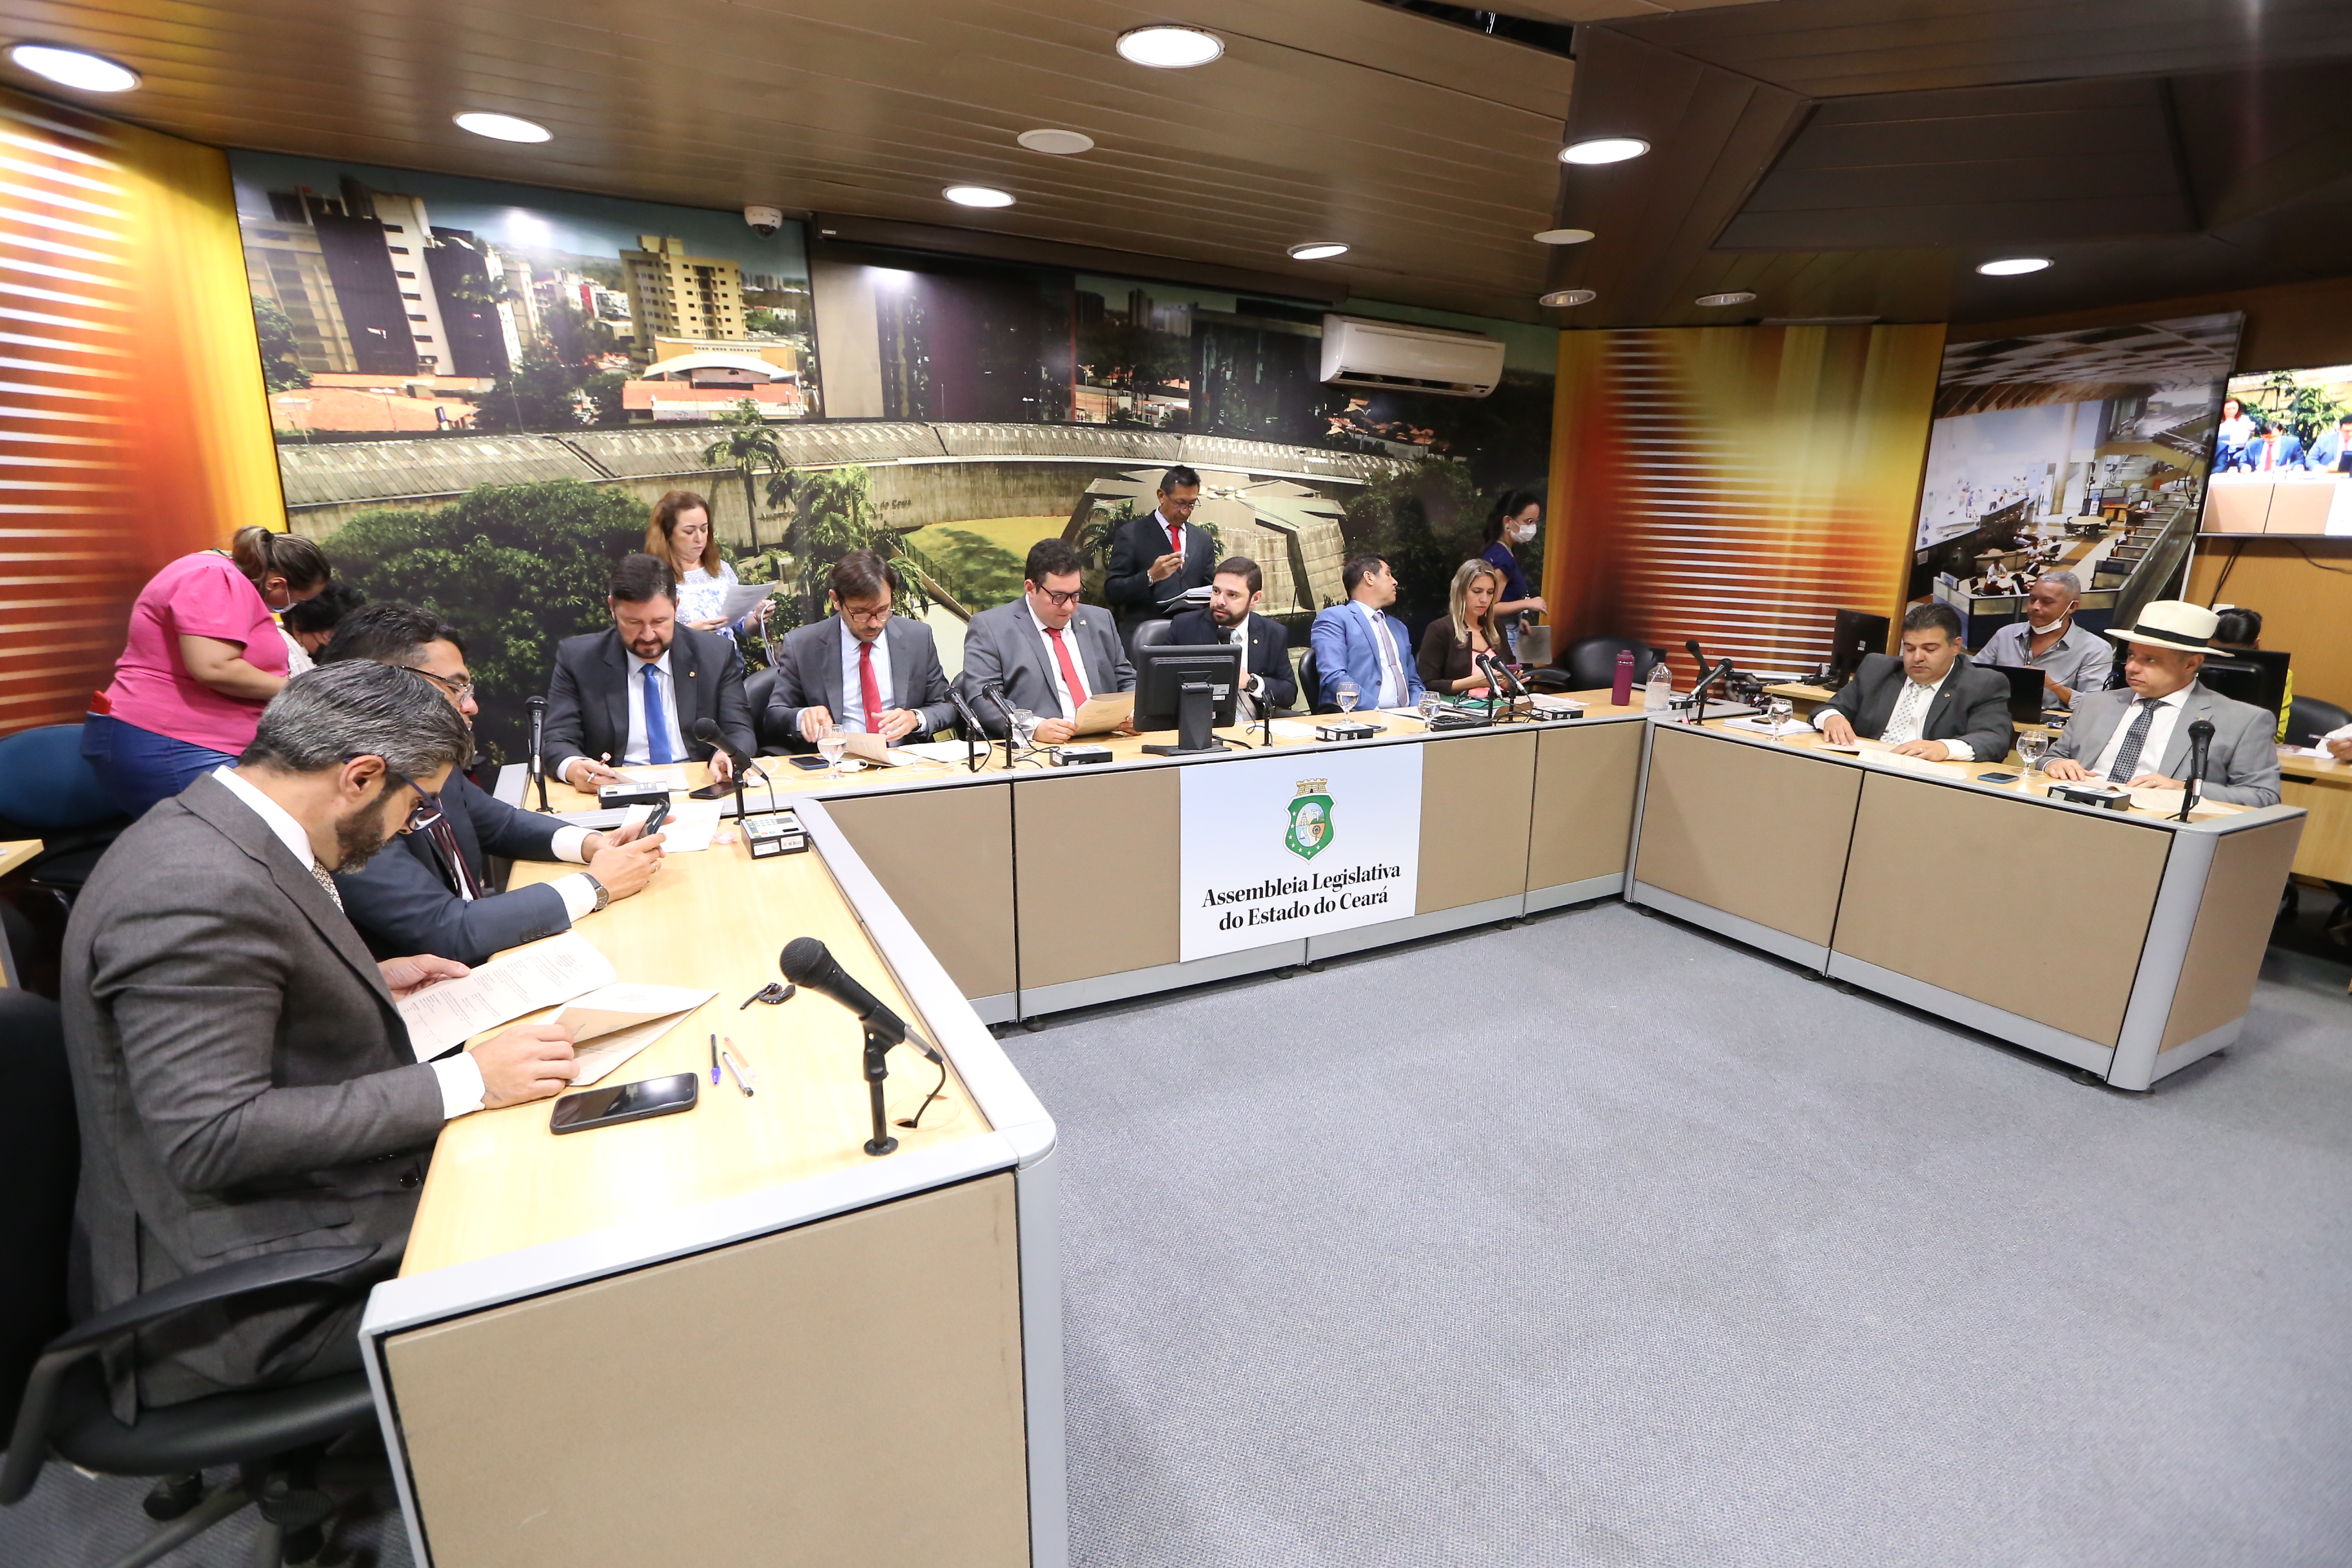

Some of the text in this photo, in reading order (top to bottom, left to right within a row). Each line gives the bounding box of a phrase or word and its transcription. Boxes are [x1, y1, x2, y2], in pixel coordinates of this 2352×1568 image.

[1202, 863, 1401, 908] Assembleia Legislativa
[1219, 885, 1389, 931] do Estado do Ceará
